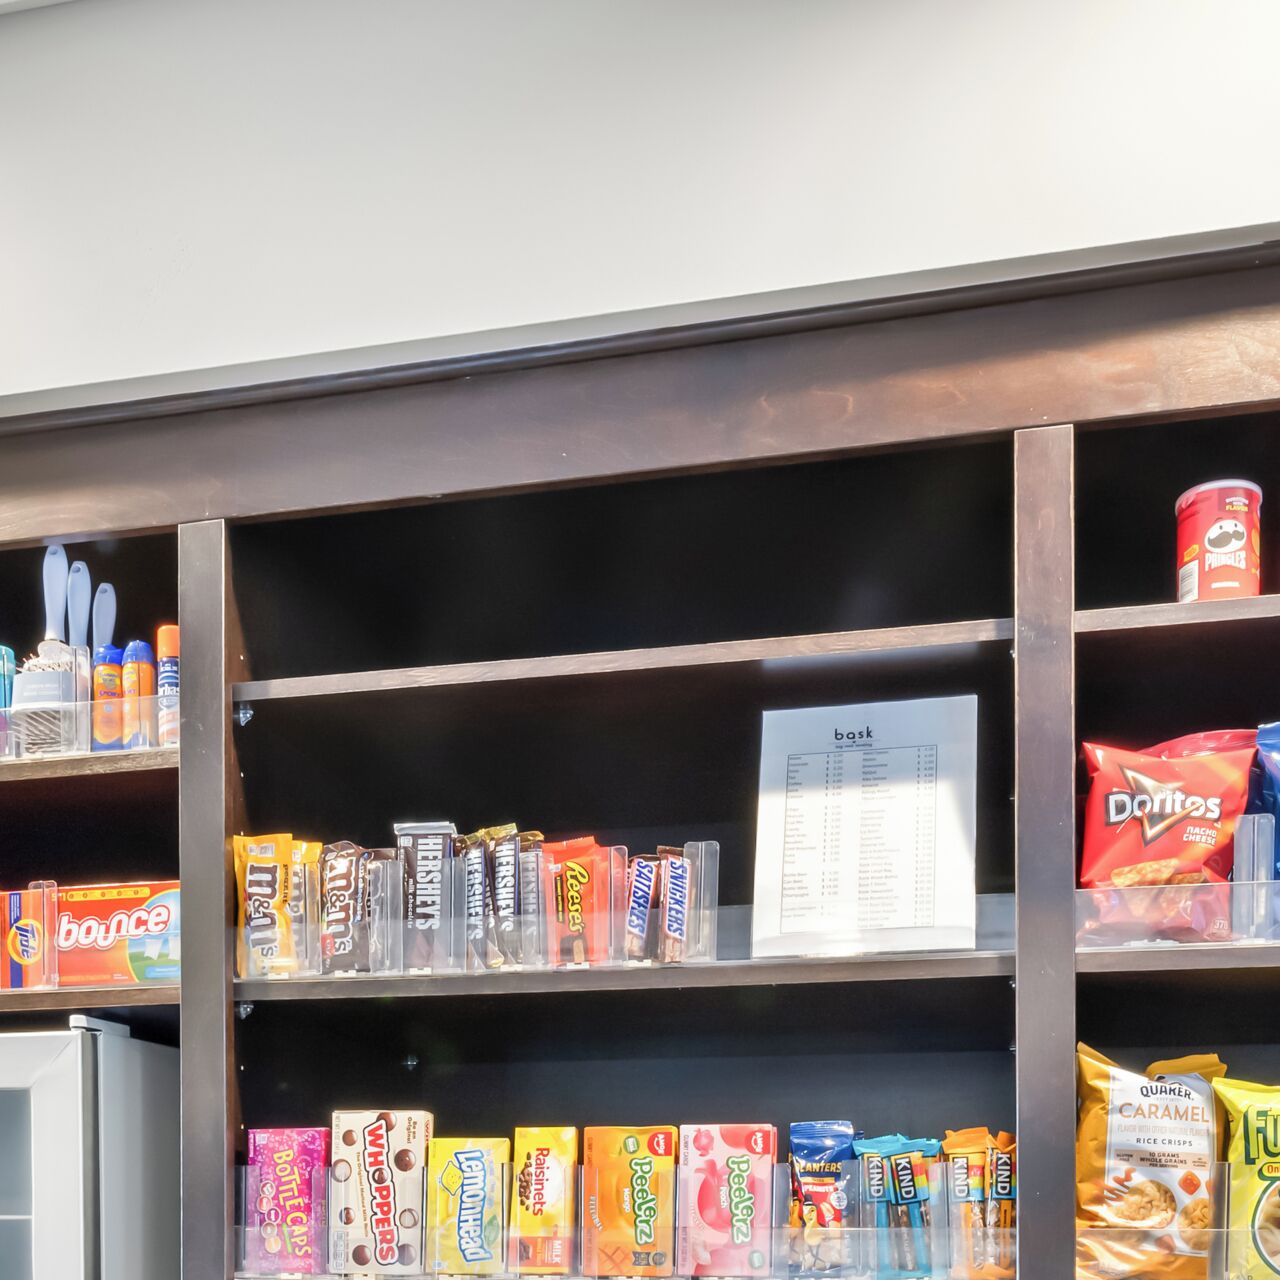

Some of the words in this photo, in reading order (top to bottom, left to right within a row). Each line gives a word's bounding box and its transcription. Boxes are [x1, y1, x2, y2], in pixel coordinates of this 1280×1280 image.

[1205, 550, 1246, 571] PRINGLES
[834, 726, 873, 742] bask
[1107, 791, 1222, 824] Doritos
[1182, 834, 1217, 846] CHEESE
[1186, 826, 1217, 837] NACHO
[416, 838, 443, 930] HERSHEY'S
[564, 860, 590, 934] Reese's
[628, 858, 655, 937] SATISFIES
[666, 861, 689, 940] SNICKERS
[14, 923, 37, 959] Tide
[58, 905, 170, 948] bounce
[1140, 1084, 1192, 1100] QUAKER
[1118, 1102, 1210, 1123] CARAMEL
[1161, 1138, 1193, 1147] CRISPS
[273, 1149, 304, 1211] BOTTLE
[367, 1123, 396, 1262] WHOPPERS
[532, 1148, 550, 1216] Raisinets
[868, 1157, 884, 1197] KIND
[895, 1158, 915, 1199] KIND
[954, 1157, 968, 1197] KIND
[997, 1153, 1011, 1194] KIND
[622, 1188, 631, 1213] Mango
[631, 1158, 656, 1245] Peelerz
[728, 1157, 753, 1243] Peelerz
[286, 1212, 312, 1257] CAPS
[552, 1240, 561, 1263] MILK
